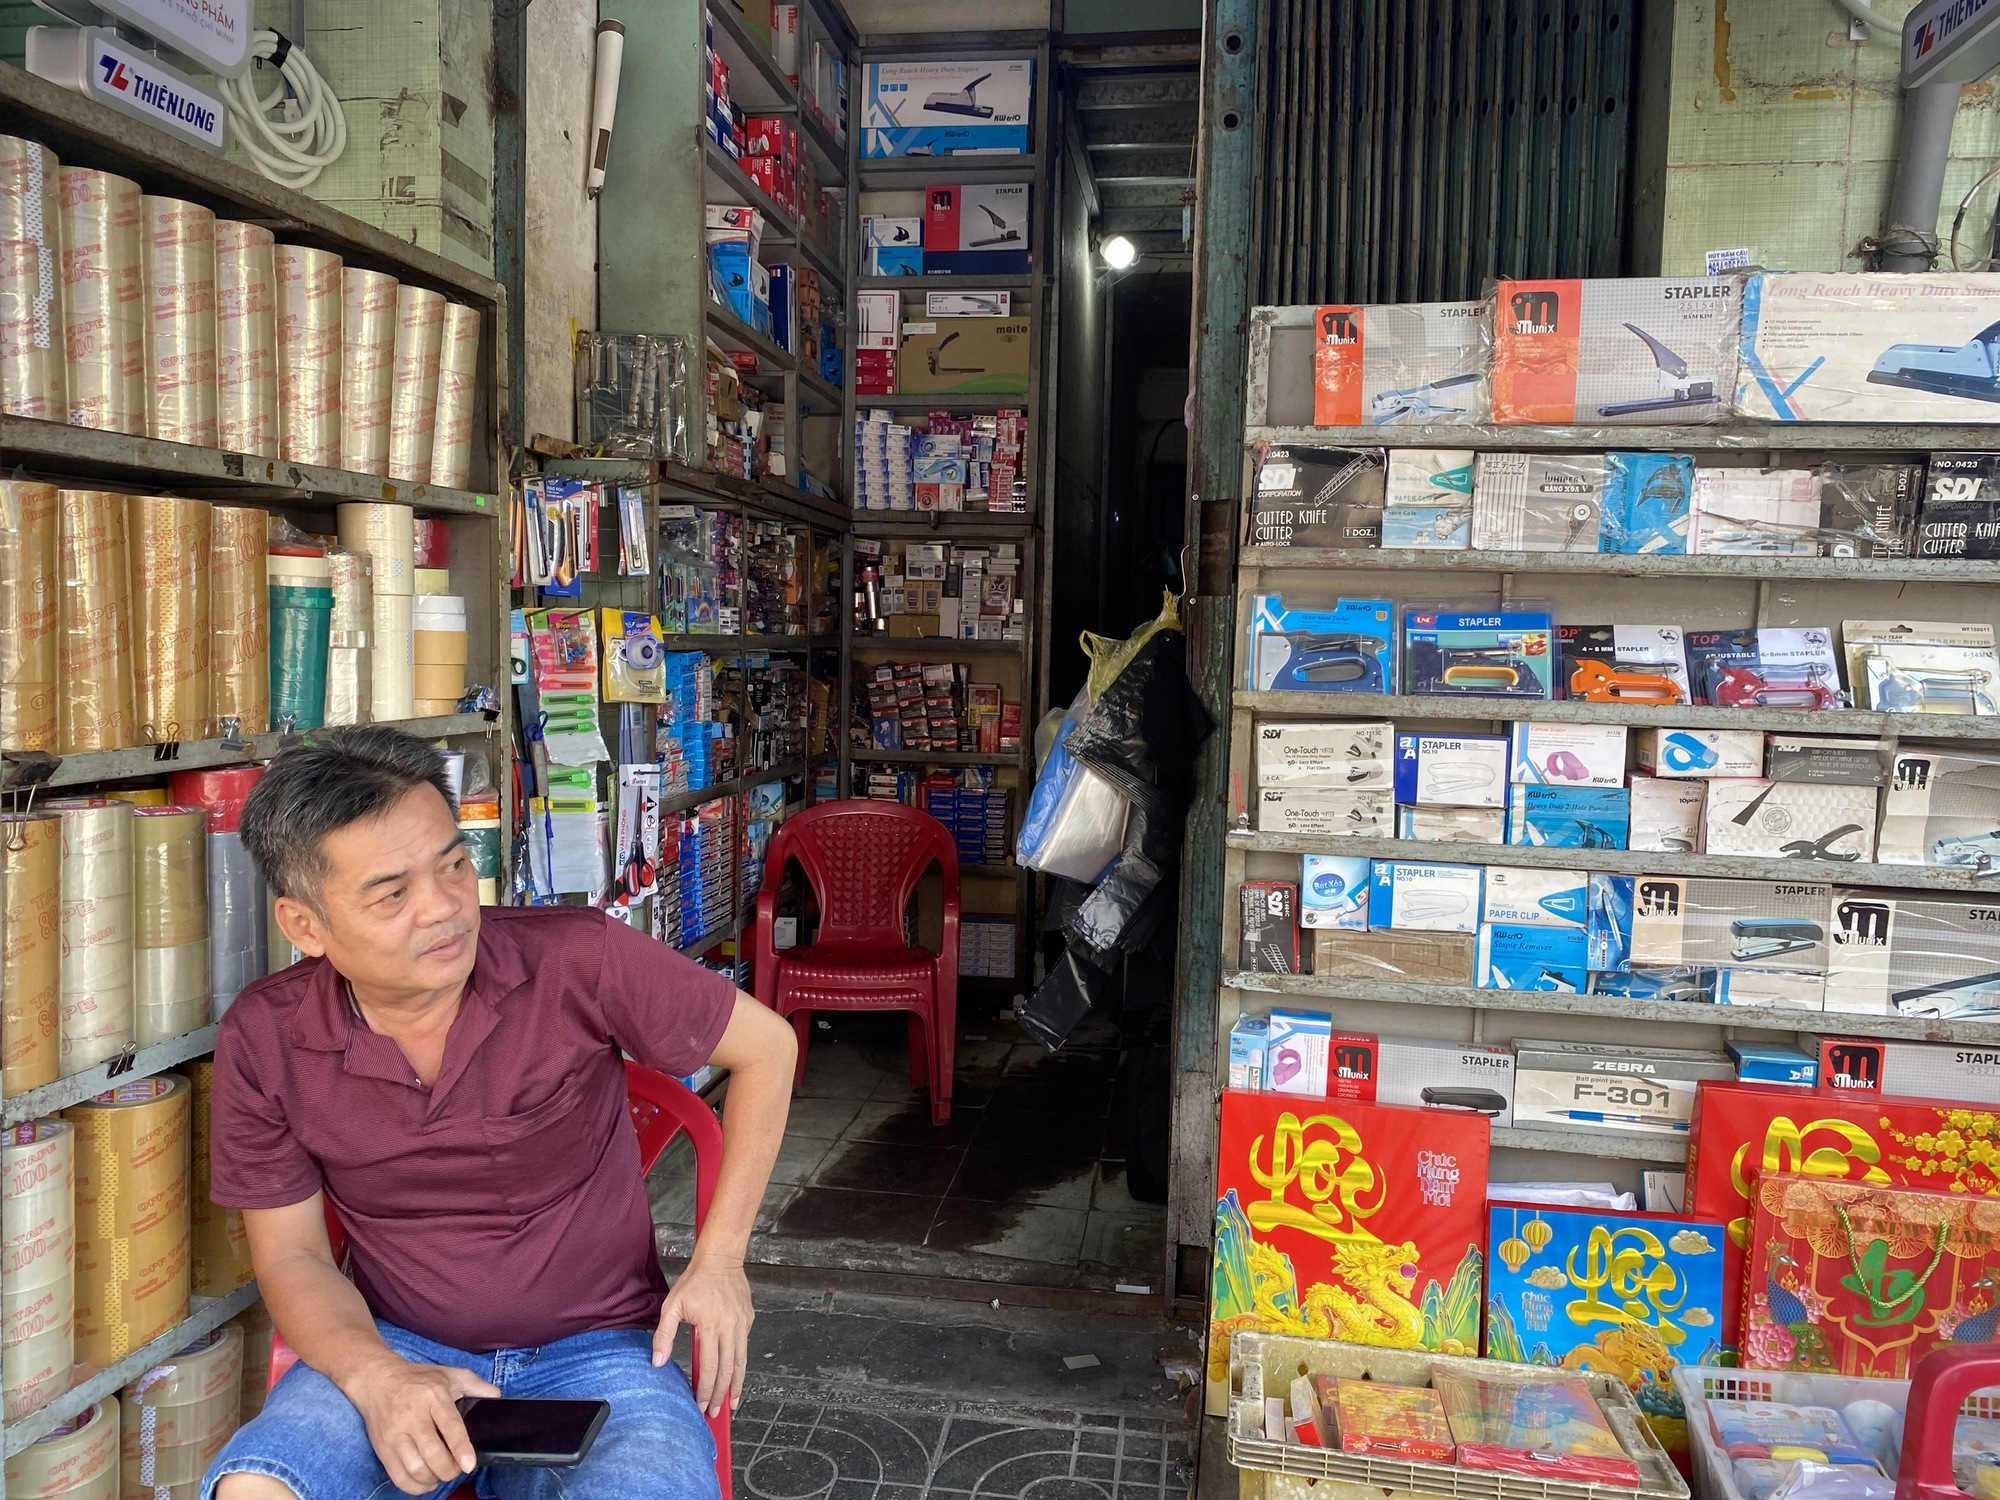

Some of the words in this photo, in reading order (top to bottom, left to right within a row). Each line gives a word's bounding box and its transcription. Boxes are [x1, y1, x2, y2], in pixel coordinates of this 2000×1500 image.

[1664, 285, 1731, 299] STAPLER
[1768, 283, 1808, 299] Long
[1813, 283, 1861, 297] Reach
[1865, 283, 1916, 298] Heavy
[996, 324, 1027, 334] meite
[1936, 460, 1978, 468] NO.0423
[1931, 477, 1984, 500] SDI
[1257, 490, 1302, 499] CORPORATION
[1930, 502, 1984, 510] CORPORATION
[1256, 511, 1294, 525] CUTTER
[1299, 510, 1327, 524] KNIFE
[1255, 526, 1293, 540] CUTTER
[1925, 523, 1968, 537] CUTTER
[1923, 540, 1965, 554] CUTTER
[1458, 617, 1502, 627] STAPLER
[1691, 634, 1720, 645] TOP
[1262, 729, 1282, 739] SDI
[1284, 746, 1318, 754] One-Touch
[1422, 741, 1461, 750] STAPLER
[1285, 809, 1319, 817] One-Touch
[81, 829, 115, 850] YARD
[1396, 868, 1436, 878] STAPLER
[1774, 885, 1826, 896] STAPLER
[1268, 891, 1283, 917] SDI
[1489, 909, 1517, 919] PAPER
[1519, 911, 1540, 920] CLIP
[1493, 931, 1523, 939] KW-triO
[1493, 940, 1516, 949] Staple
[1518, 942, 1553, 951] Remover
[1461, 1055, 1510, 1069] STAPLER
[1592, 1060, 1656, 1075] ZEBRA
[1575, 1075, 1590, 1083] Ball
[1590, 1077, 1609, 1085] point
[1833, 1073, 1875, 1089] Munix
[1573, 1082, 1670, 1109] F-301
[1417, 1150, 1457, 1167] Chúc
[1521, 1290, 1551, 1303] Chúc
